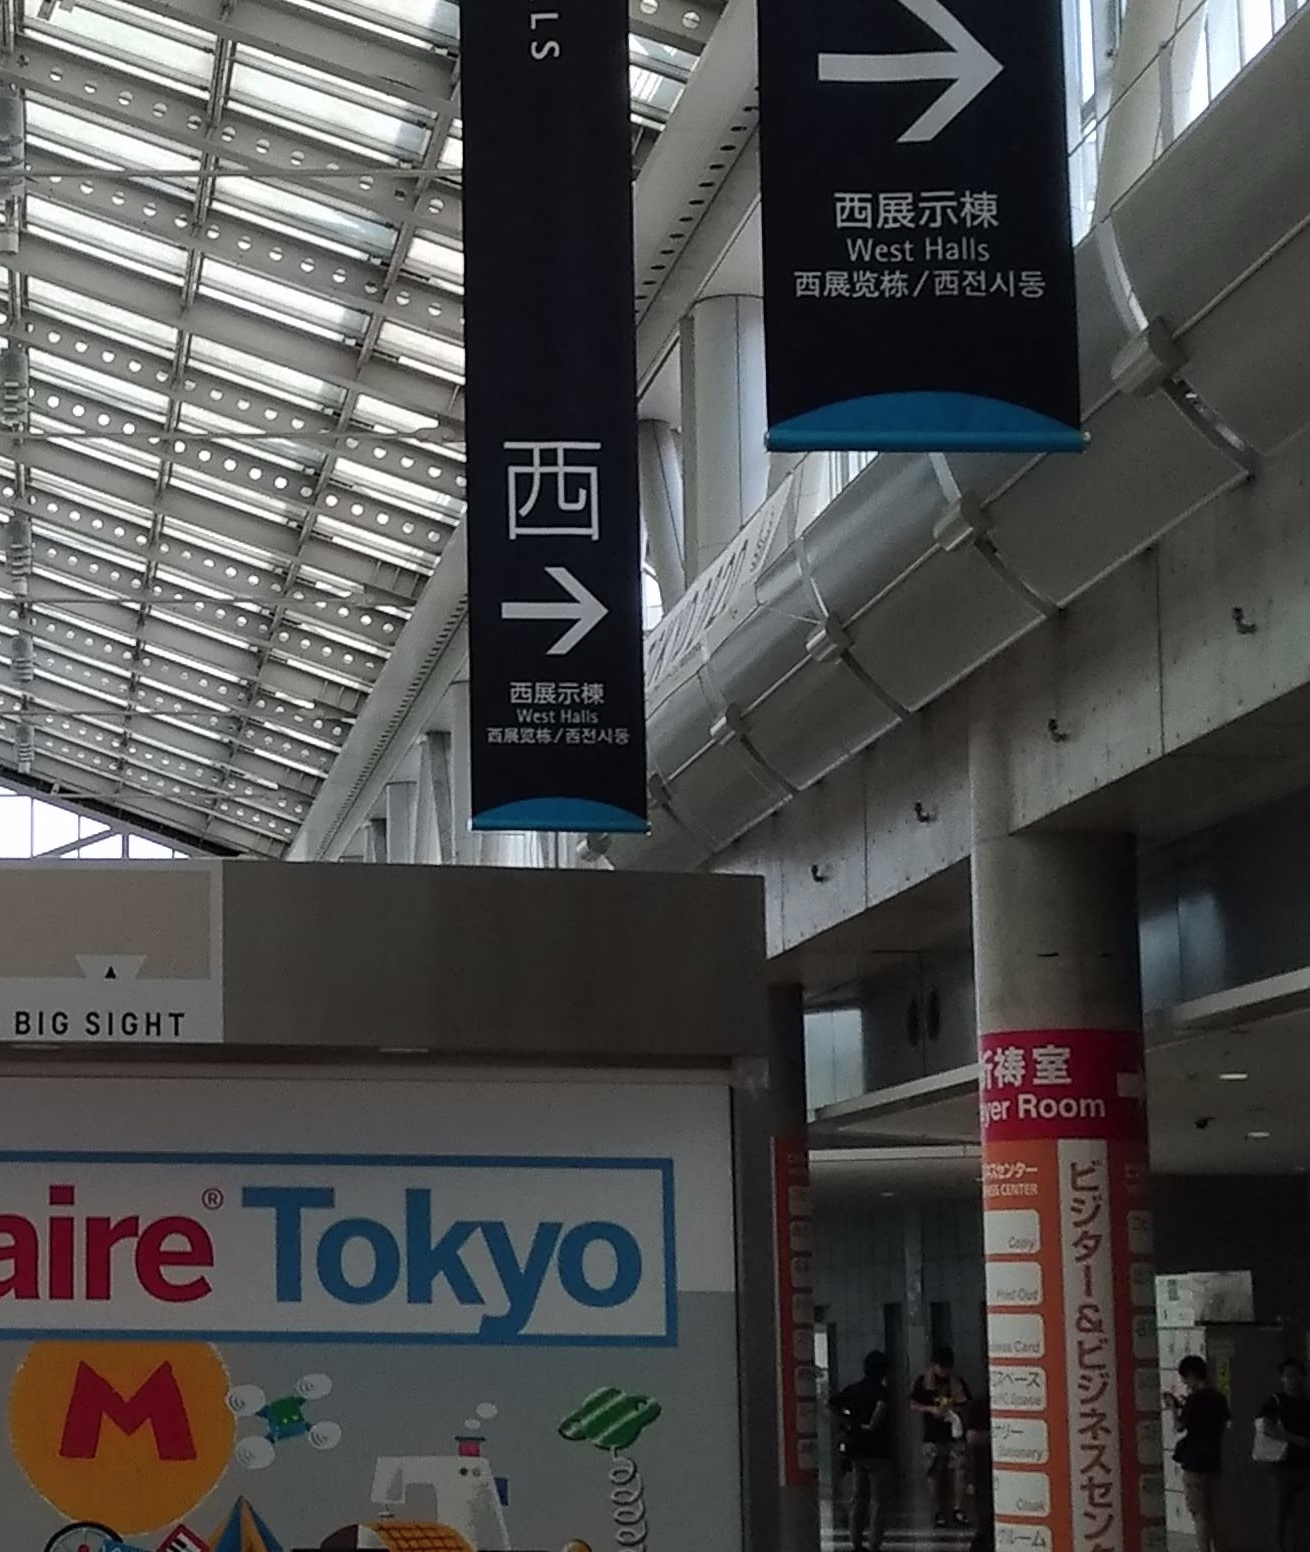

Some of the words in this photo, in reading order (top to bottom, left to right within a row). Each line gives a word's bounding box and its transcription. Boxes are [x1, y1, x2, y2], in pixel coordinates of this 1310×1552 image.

[834, 190, 999, 229] 西展示棟
[847, 237, 914, 262] West
[925, 236, 990, 262] Halls
[503, 441, 601, 541] 西
[509, 681, 605, 705] 西展示棟
[516, 708, 557, 724] West
[560, 708, 599, 724] Halls
[15, 1011, 69, 1036] BIG
[85, 1012, 185, 1037] SIGHT
[1017, 1093, 1106, 1119] Room
[241, 1187, 642, 1336] Tokyo
